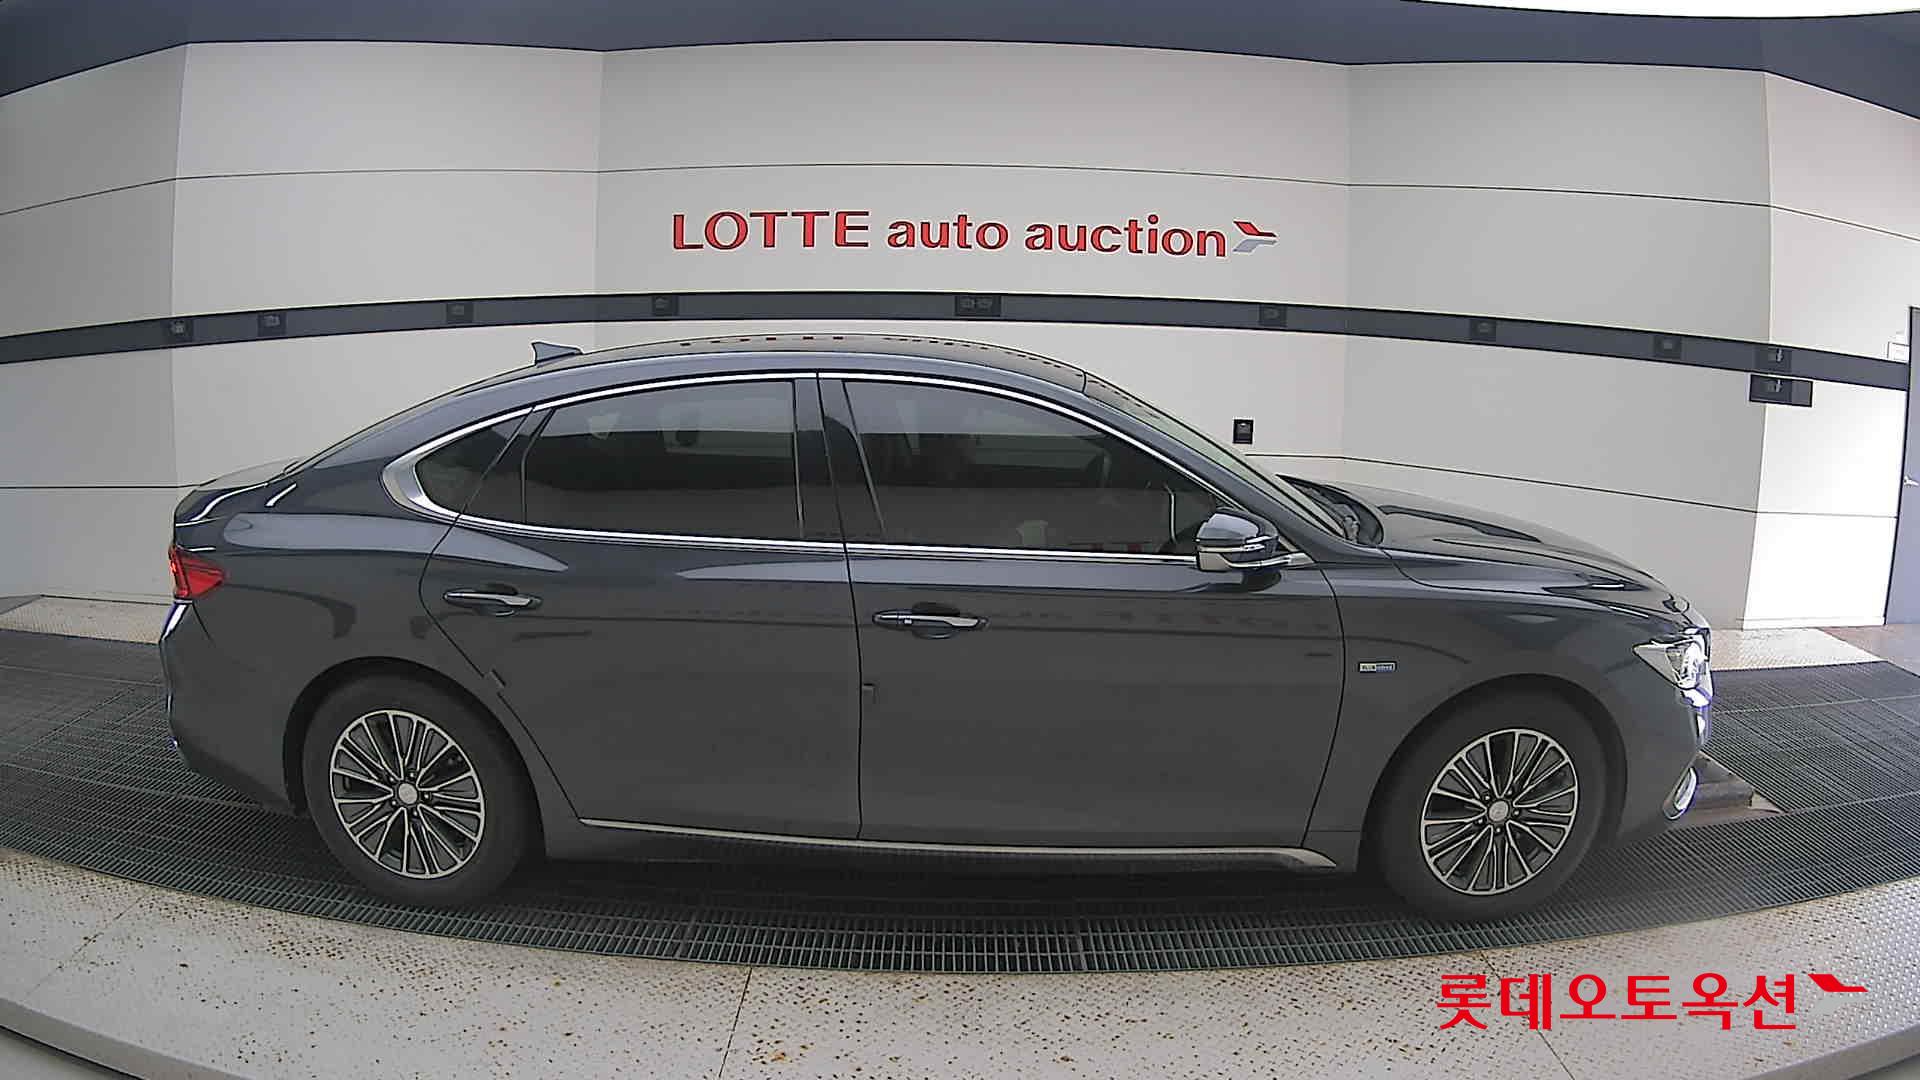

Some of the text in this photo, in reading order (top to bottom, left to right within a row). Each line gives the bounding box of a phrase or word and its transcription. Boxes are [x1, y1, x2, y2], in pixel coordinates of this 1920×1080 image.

[673, 211, 1228, 258] LOTTE auto auction
